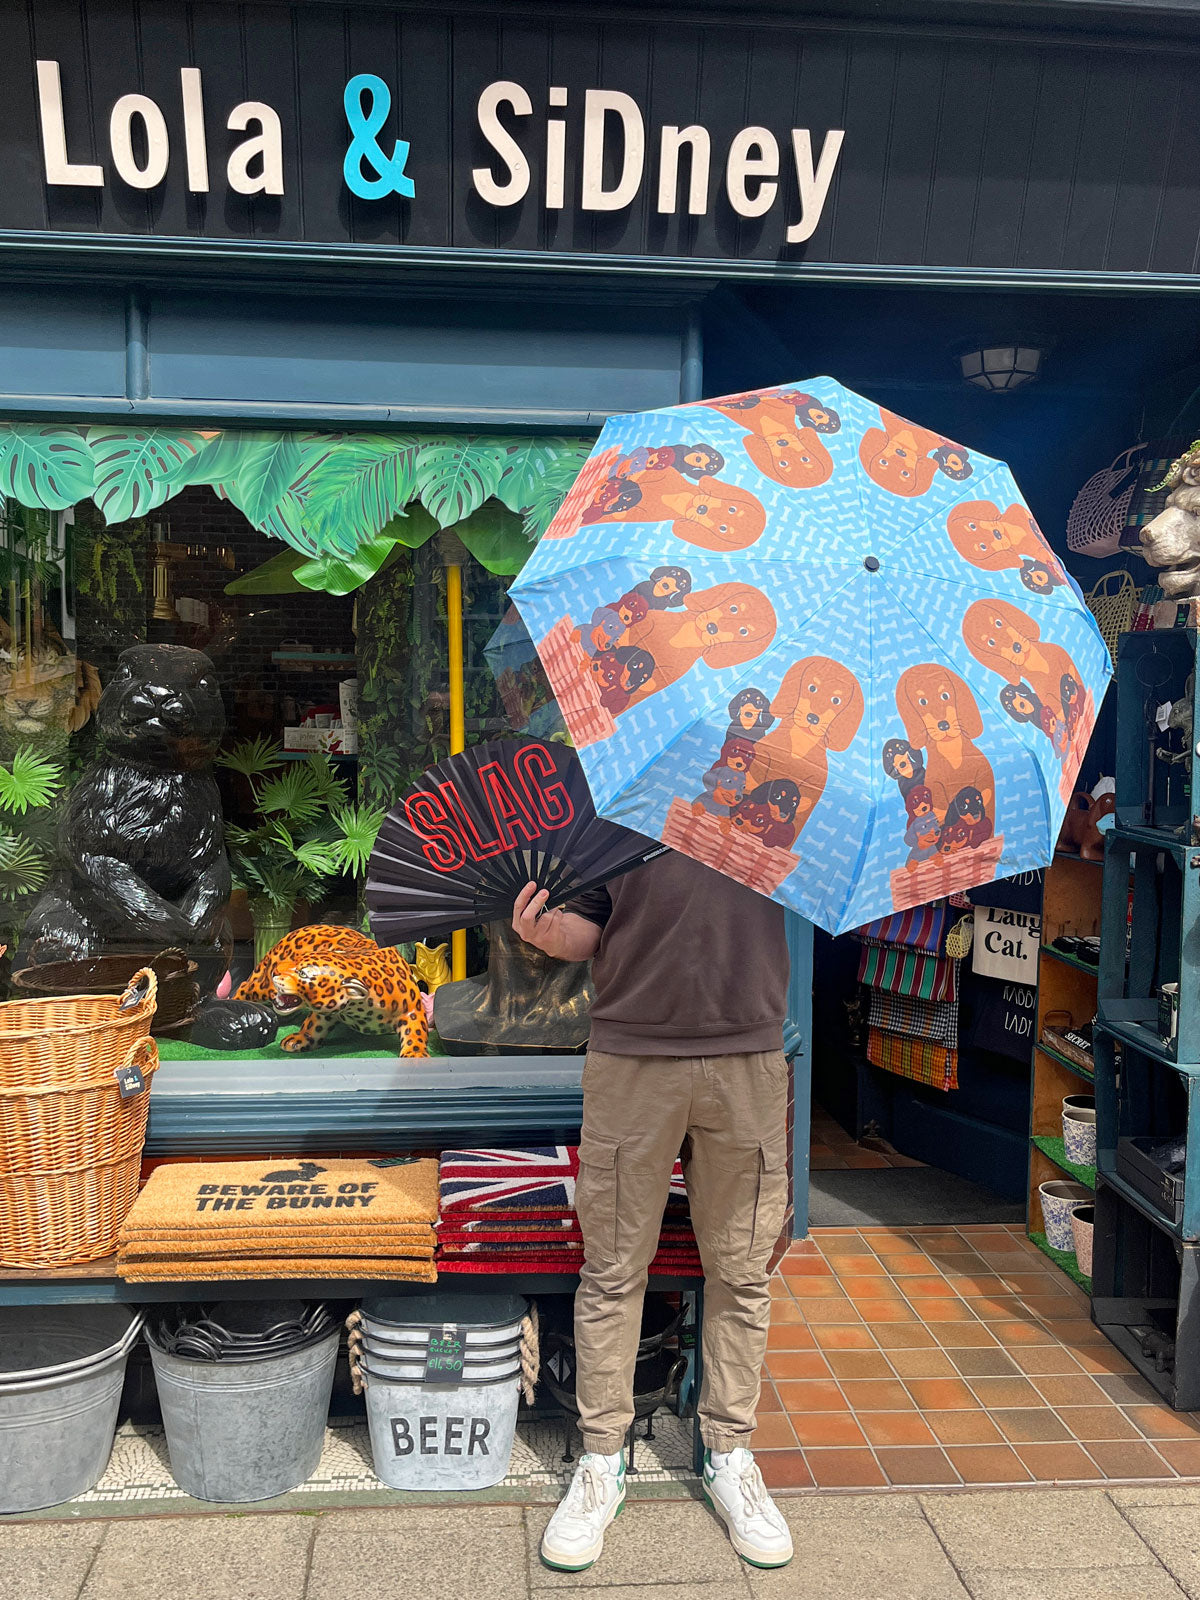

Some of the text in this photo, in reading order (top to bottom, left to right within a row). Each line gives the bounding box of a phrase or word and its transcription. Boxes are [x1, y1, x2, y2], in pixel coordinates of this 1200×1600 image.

[36, 60, 846, 244] Lola & SiDney
[405, 743, 575, 872] SLAG
[985, 931, 1028, 960] Cat.
[1064, 1031, 1092, 1050] SECRET
[198, 1182, 379, 1196] BEWARE OF
[196, 1195, 377, 1211] THE BUNNY
[430, 1338, 462, 1348] BEER
[390, 1415, 491, 1457] BEER
